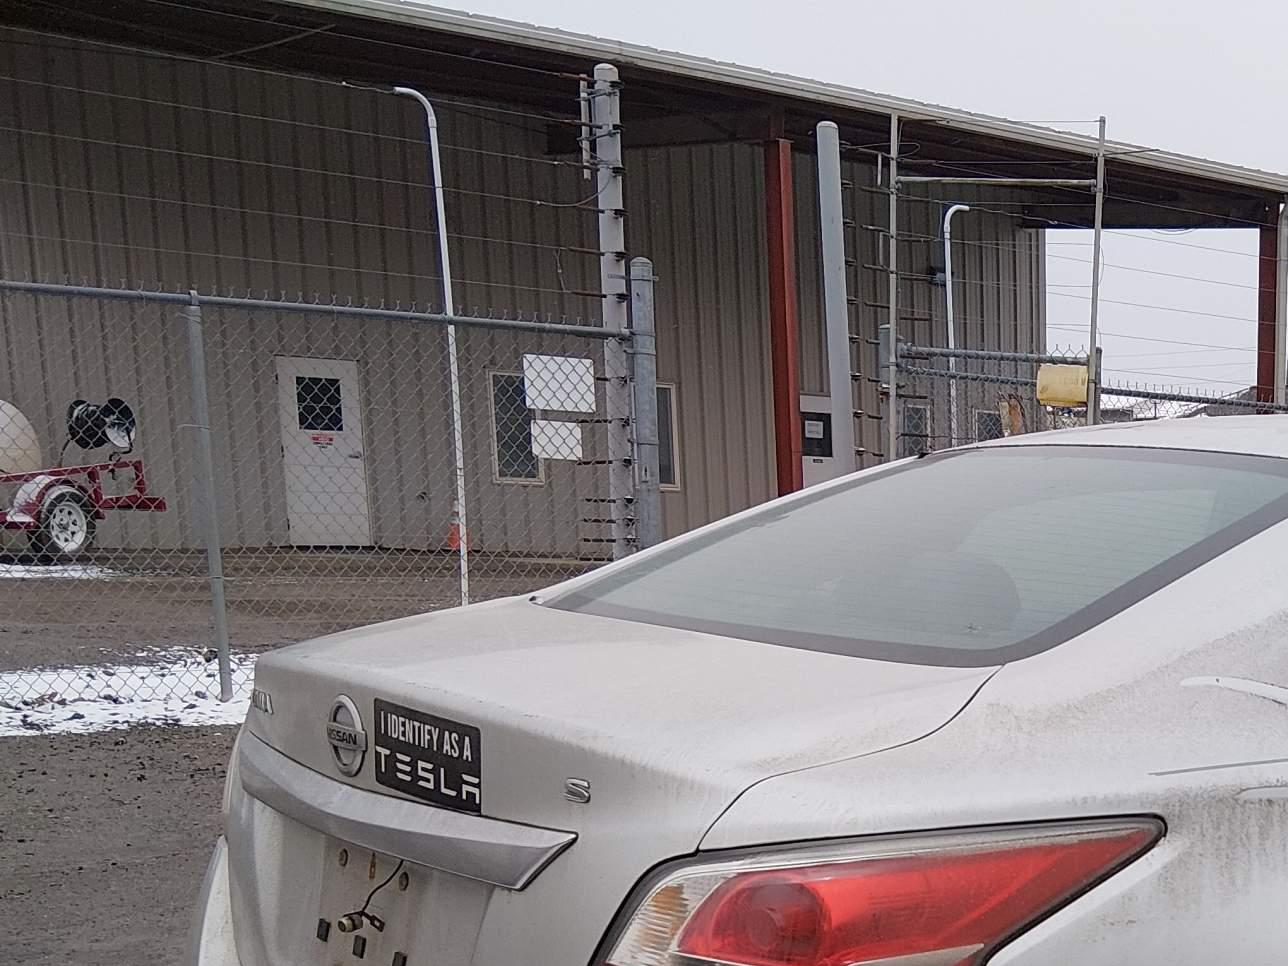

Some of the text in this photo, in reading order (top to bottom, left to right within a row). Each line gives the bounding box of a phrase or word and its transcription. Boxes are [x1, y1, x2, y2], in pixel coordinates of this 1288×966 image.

[380, 710, 472, 762] I IDENTIFY AS A
[375, 745, 480, 804] TESLA
[563, 777, 591, 804] S
